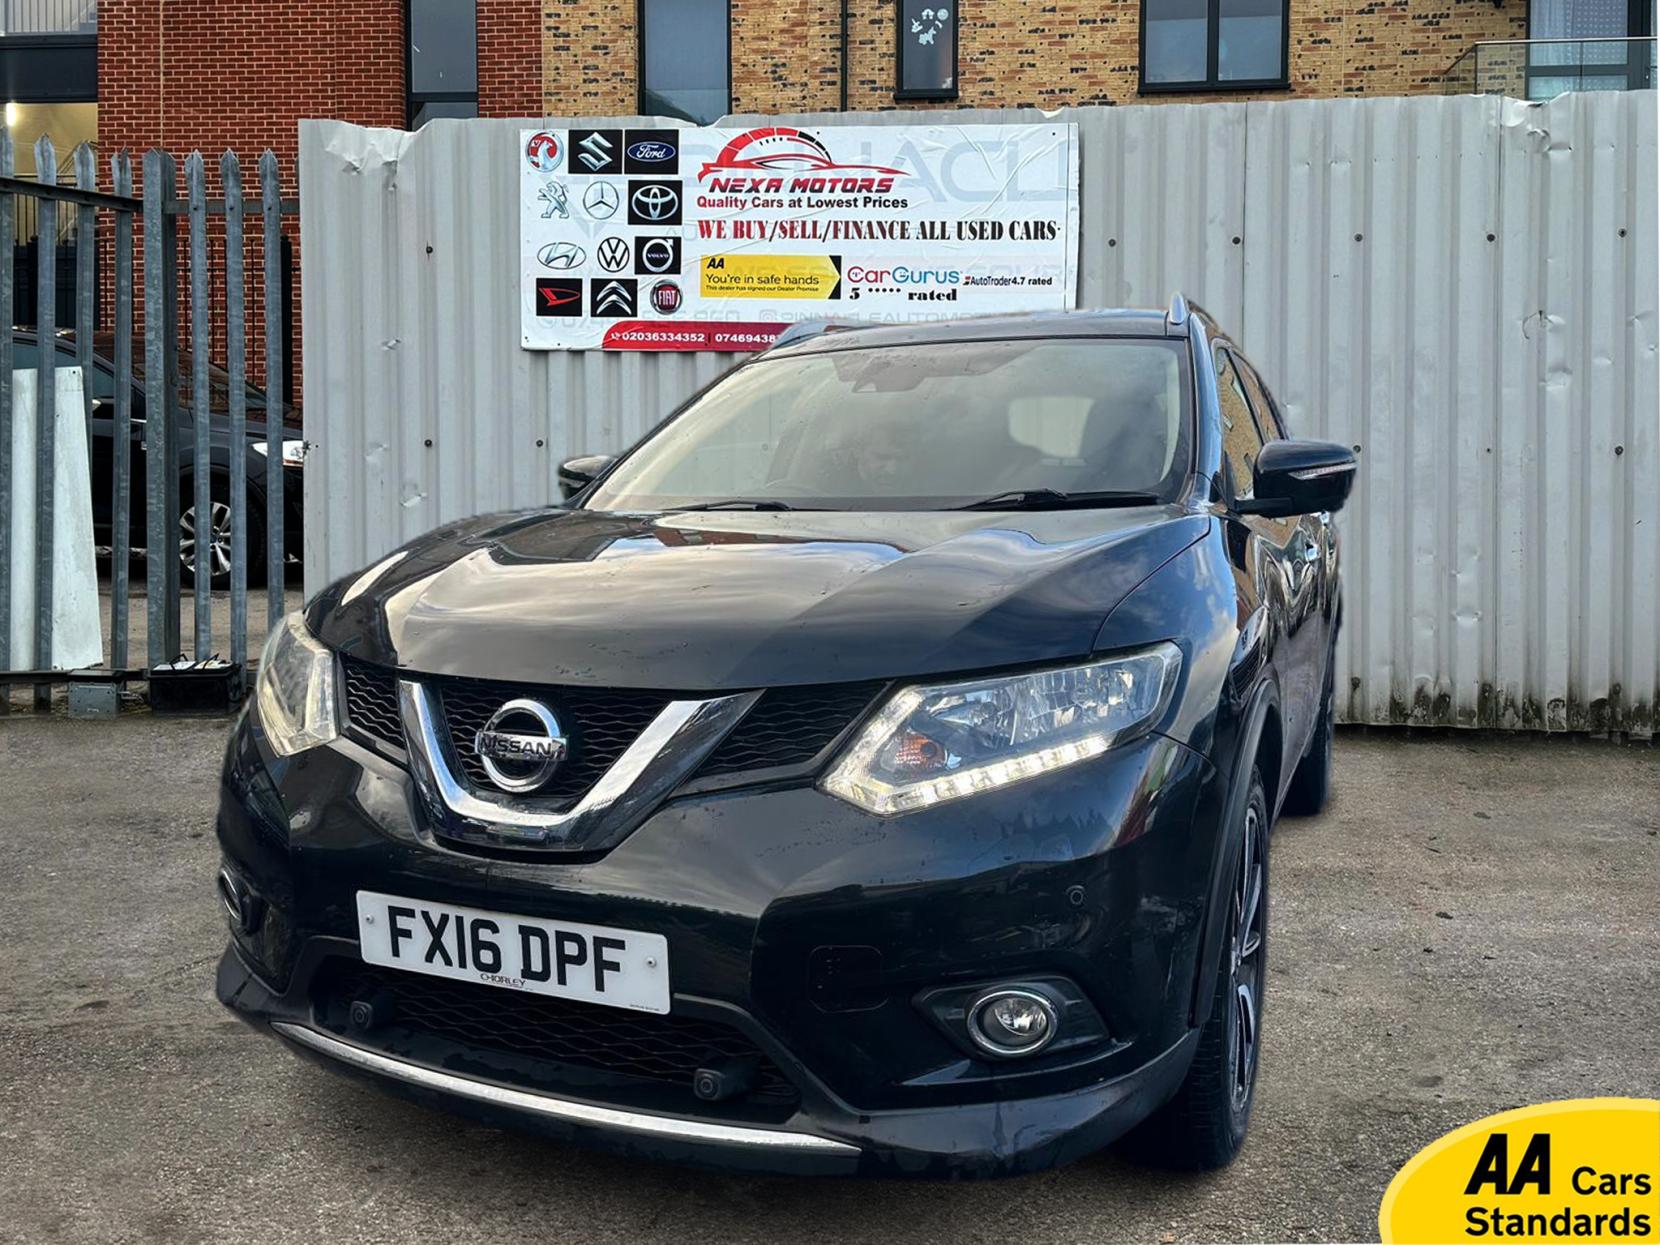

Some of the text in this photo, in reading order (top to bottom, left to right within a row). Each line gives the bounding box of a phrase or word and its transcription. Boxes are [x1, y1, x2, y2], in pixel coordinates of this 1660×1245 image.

[636, 143, 667, 159] Ford
[709, 177, 895, 193] NEXA MOTORS
[696, 196, 908, 210] Quality Cars at Lowest Prices
[697, 219, 727, 240] WE
[916, 220, 951, 240] ALL
[956, 220, 1004, 240] USED
[1009, 220, 1057, 240] CARS
[706, 257, 725, 269] AA
[706, 273, 819, 285] You're in safe hands
[847, 266, 960, 284] CarGurus
[1028, 276, 1053, 286] rated
[658, 290, 676, 306] FIAT
[849, 288, 958, 301] 5 rated
[622, 332, 779, 343] 02036334352 07469438
[483, 734, 552, 756] NISSAN
[388, 905, 626, 992] FX16 DPF
